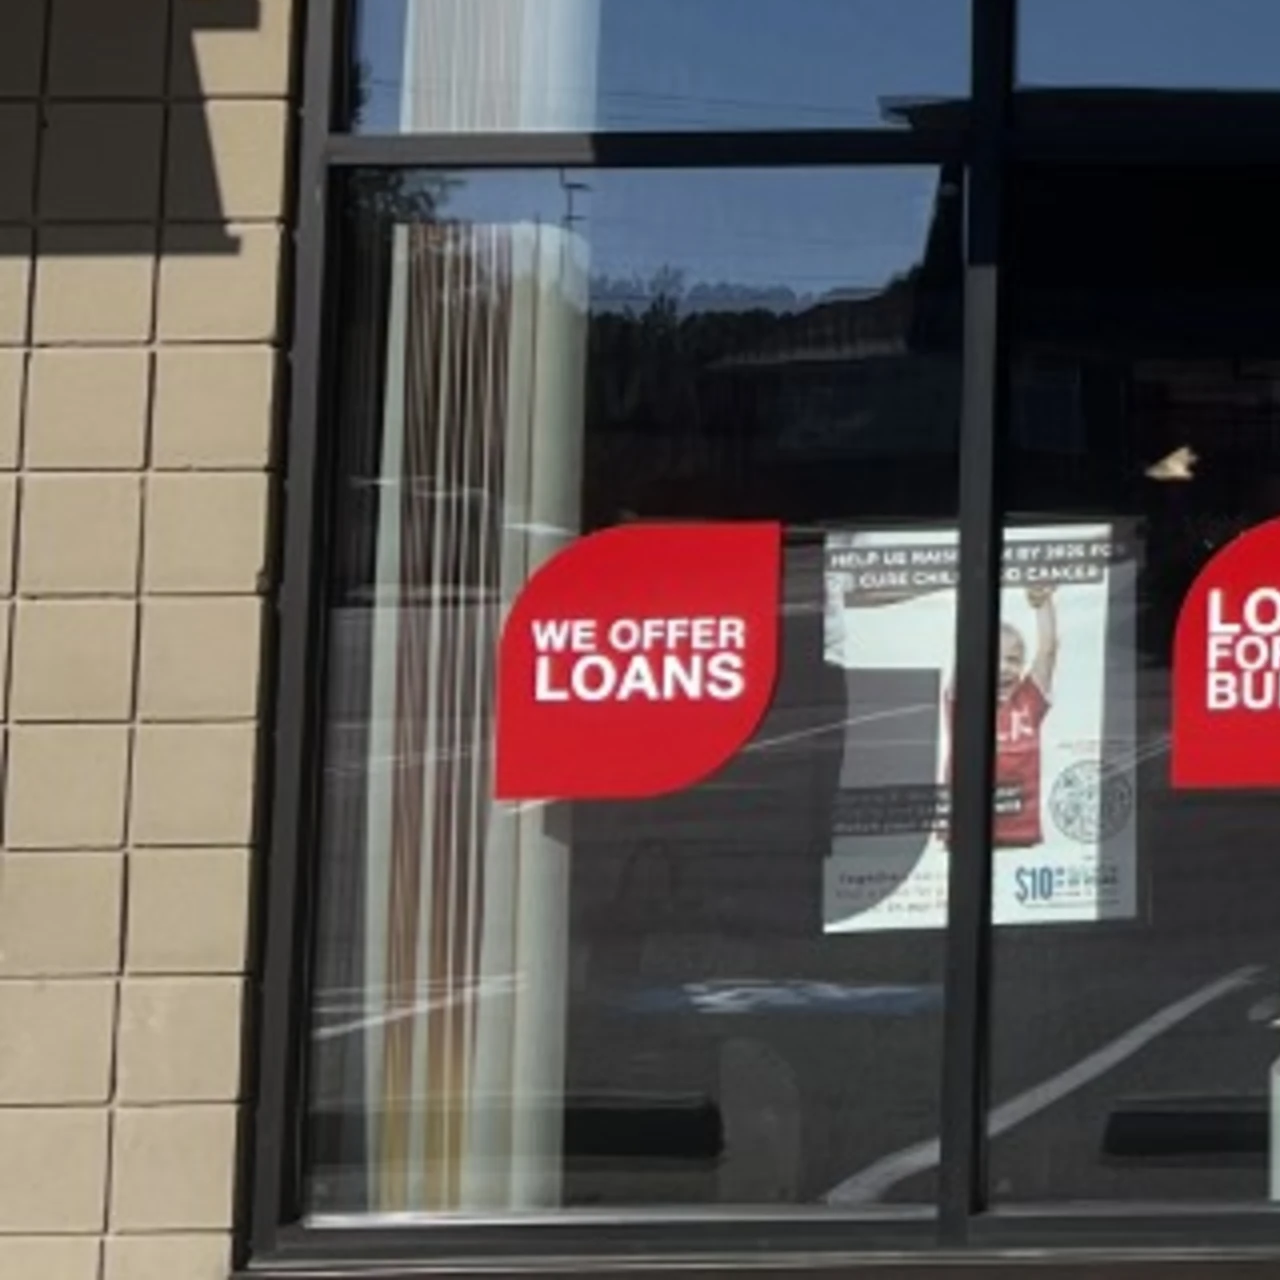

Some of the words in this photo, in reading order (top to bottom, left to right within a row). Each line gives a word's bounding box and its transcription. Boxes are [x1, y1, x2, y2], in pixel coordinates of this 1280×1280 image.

[531, 619, 598, 652] WE
[608, 617, 746, 651] OFFER
[534, 651, 745, 702] LOANS
